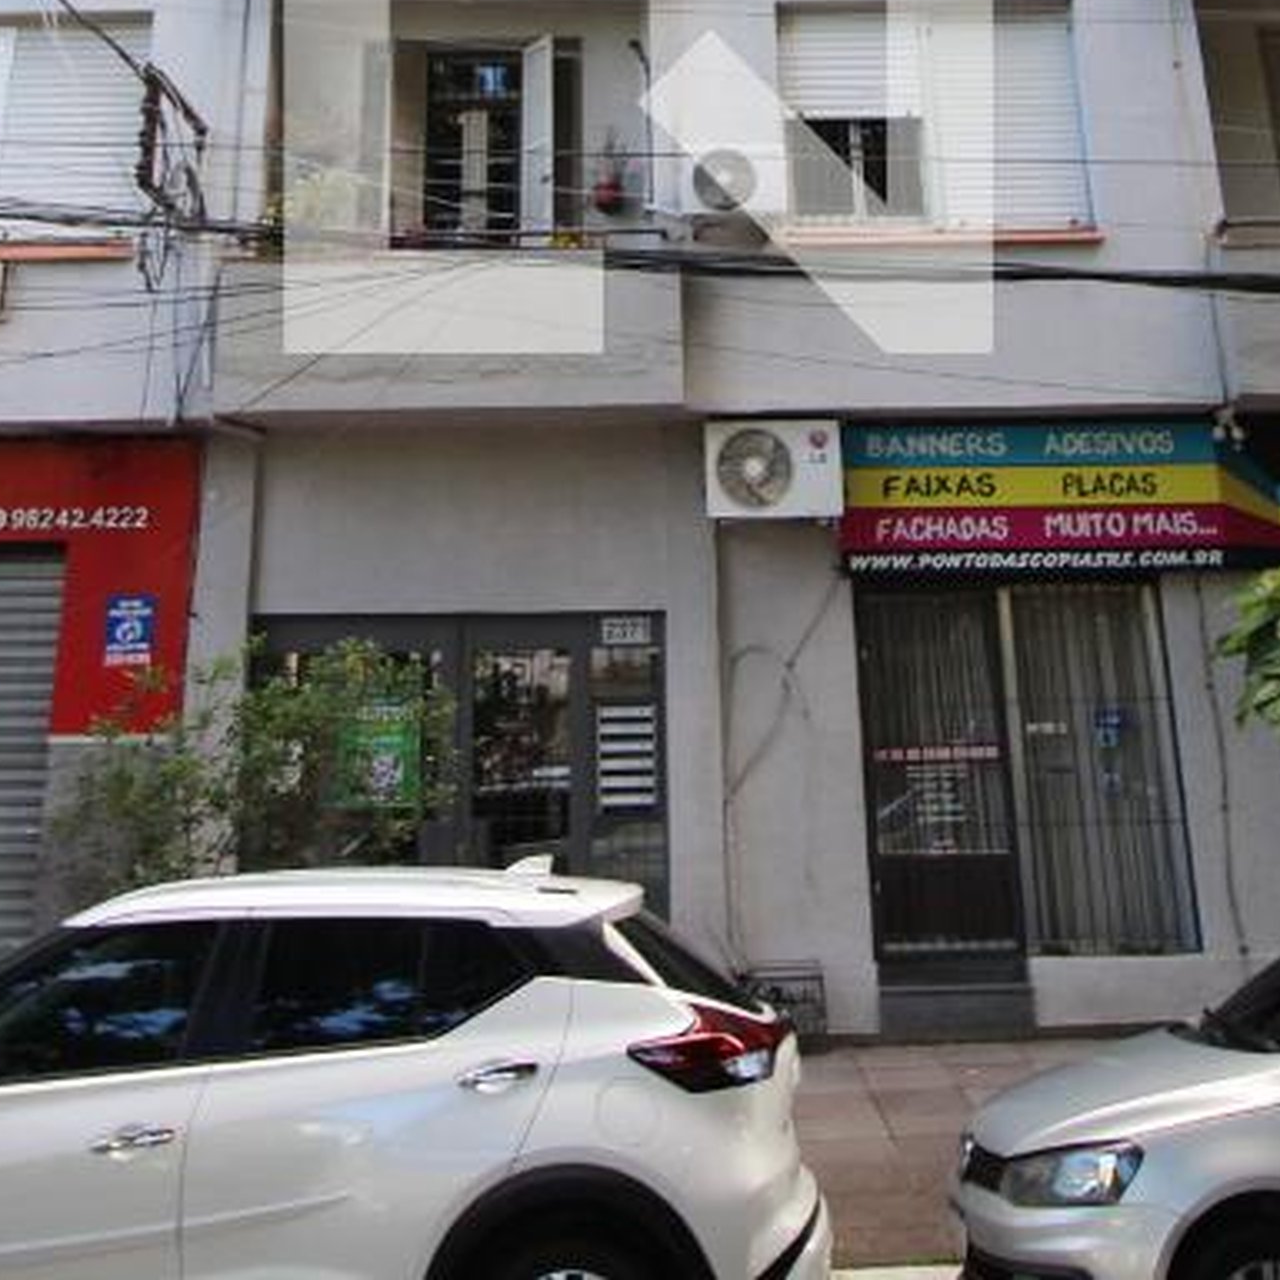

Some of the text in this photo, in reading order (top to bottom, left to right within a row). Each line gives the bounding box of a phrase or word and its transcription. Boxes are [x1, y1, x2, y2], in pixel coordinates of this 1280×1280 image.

[866, 430, 1176, 458] BANNERS ADESIVOS
[882, 472, 1157, 499] FAIXAS PLACAS
[875, 511, 1219, 542] FACHADAS MUITO MAIS...
